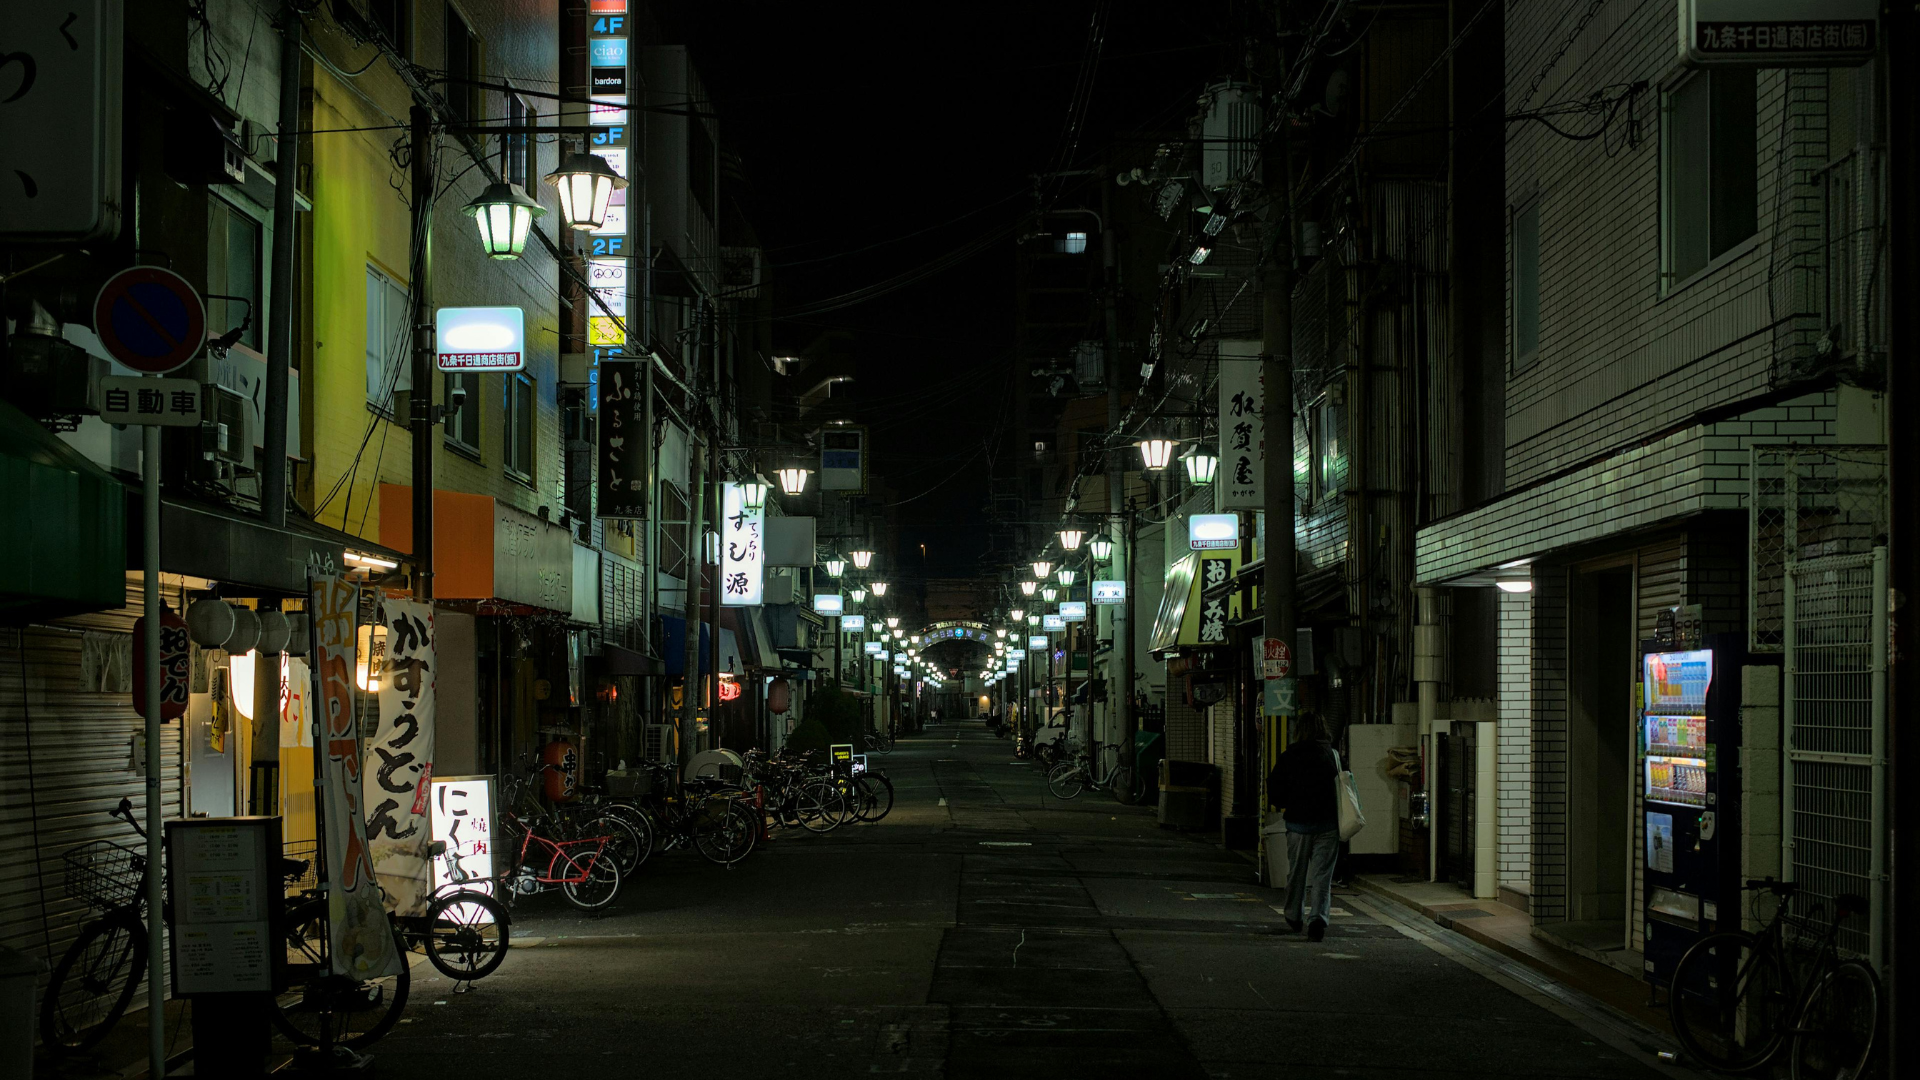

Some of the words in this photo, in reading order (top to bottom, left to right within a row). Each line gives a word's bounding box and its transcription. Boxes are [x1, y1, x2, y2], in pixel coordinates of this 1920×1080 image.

[593, 17, 624, 34] 4F
[1703, 23, 1868, 49] 九条千日通商店街(振)
[593, 44, 623, 56] ciao
[594, 77, 622, 85] bardora
[592, 128, 623, 145] 3F
[592, 238, 622, 255] 2F
[106, 387, 196, 416] 自動車
[606, 371, 631, 492] ふるさと
[1232, 489, 1256, 497] かがや
[614, 505, 642, 515] 九条店
[726, 510, 749, 595] すし源
[749, 522, 758, 561] てっちり
[1202, 560, 1226, 641] おみ焼
[1272, 686, 1295, 710] 文
[366, 612, 431, 840] かすうどん
[563, 748, 577, 796] 串かつ
[471, 817, 487, 855] 焼肉
